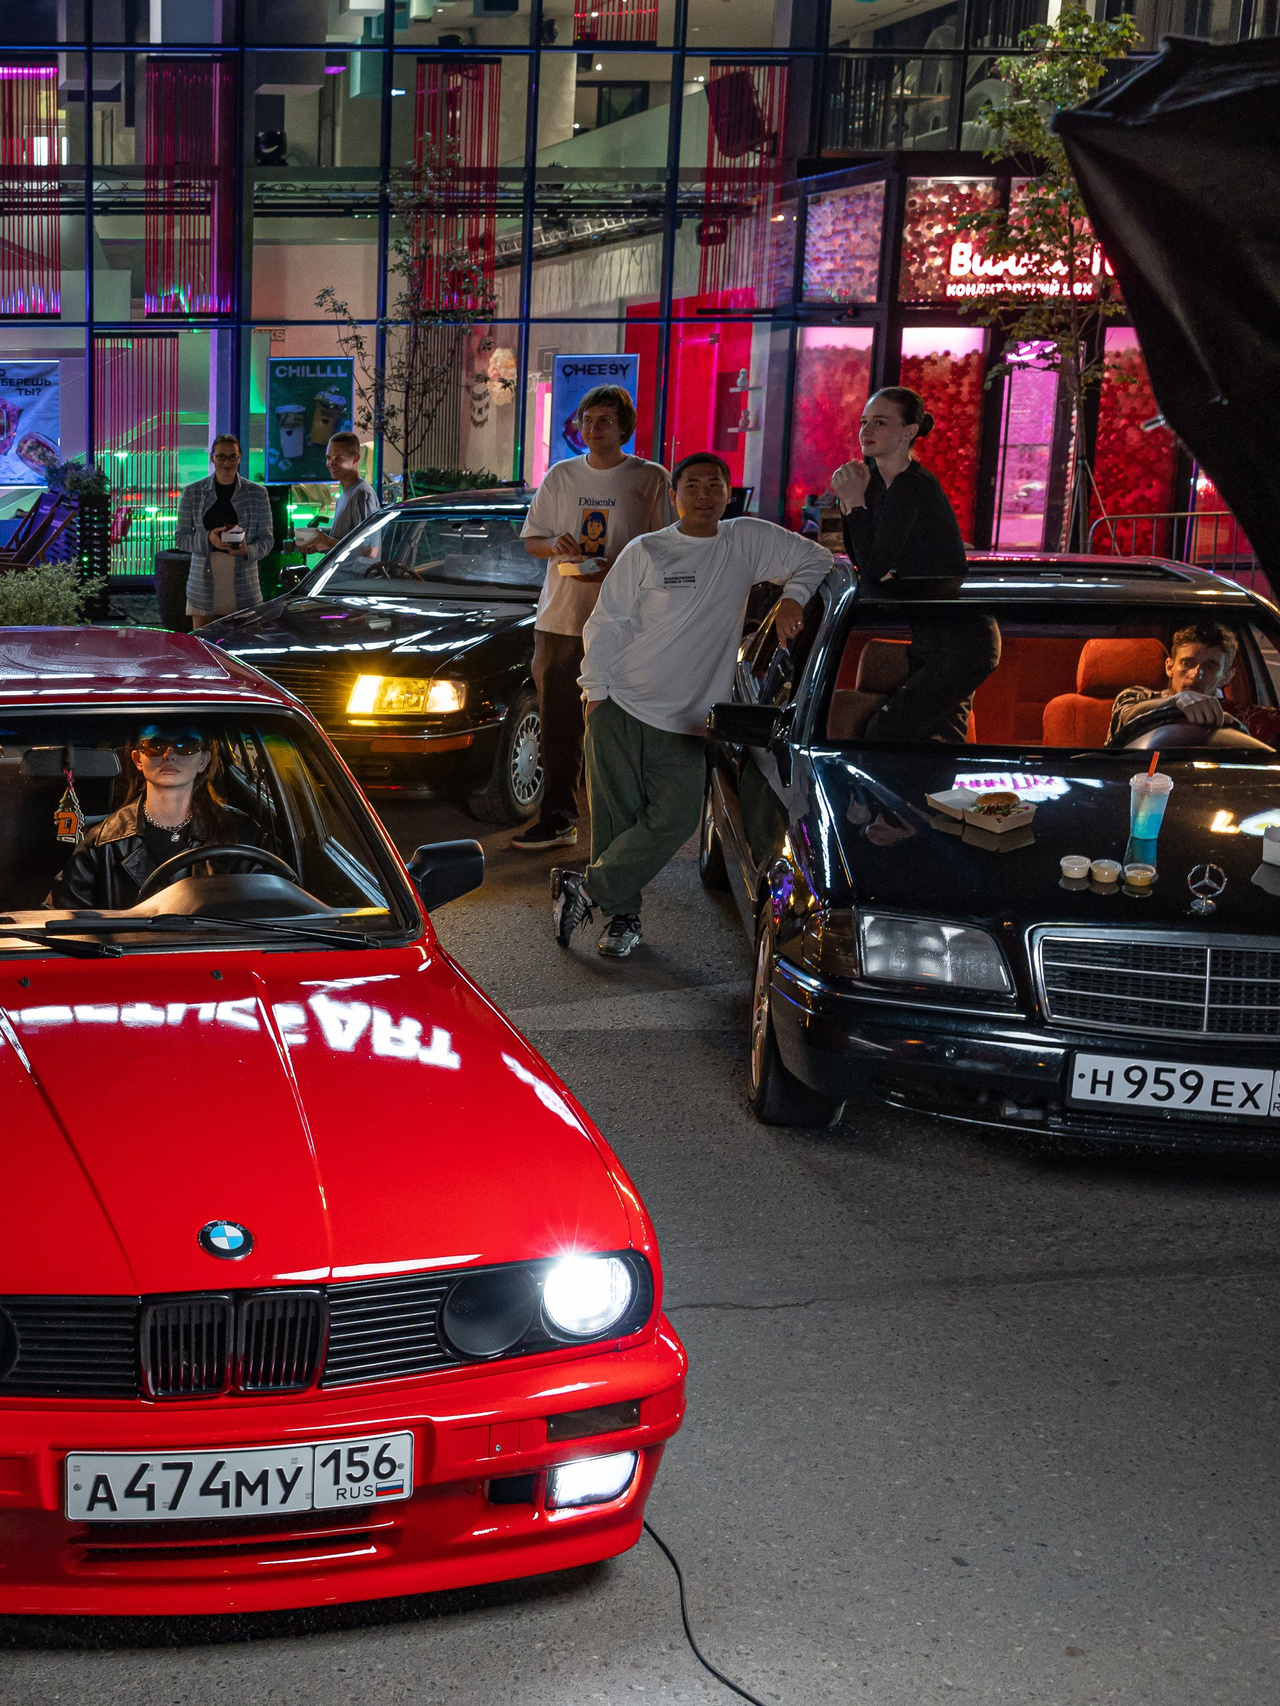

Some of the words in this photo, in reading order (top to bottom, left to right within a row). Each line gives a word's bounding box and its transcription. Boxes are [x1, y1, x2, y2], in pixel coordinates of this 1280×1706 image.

[275, 365, 348, 378] CHILLLL
[562, 363, 630, 380] CHEESY
[17, 387, 42, 396] ТЫ?
[320, 1442, 398, 1486] 156
[336, 1484, 374, 1501] RUS
